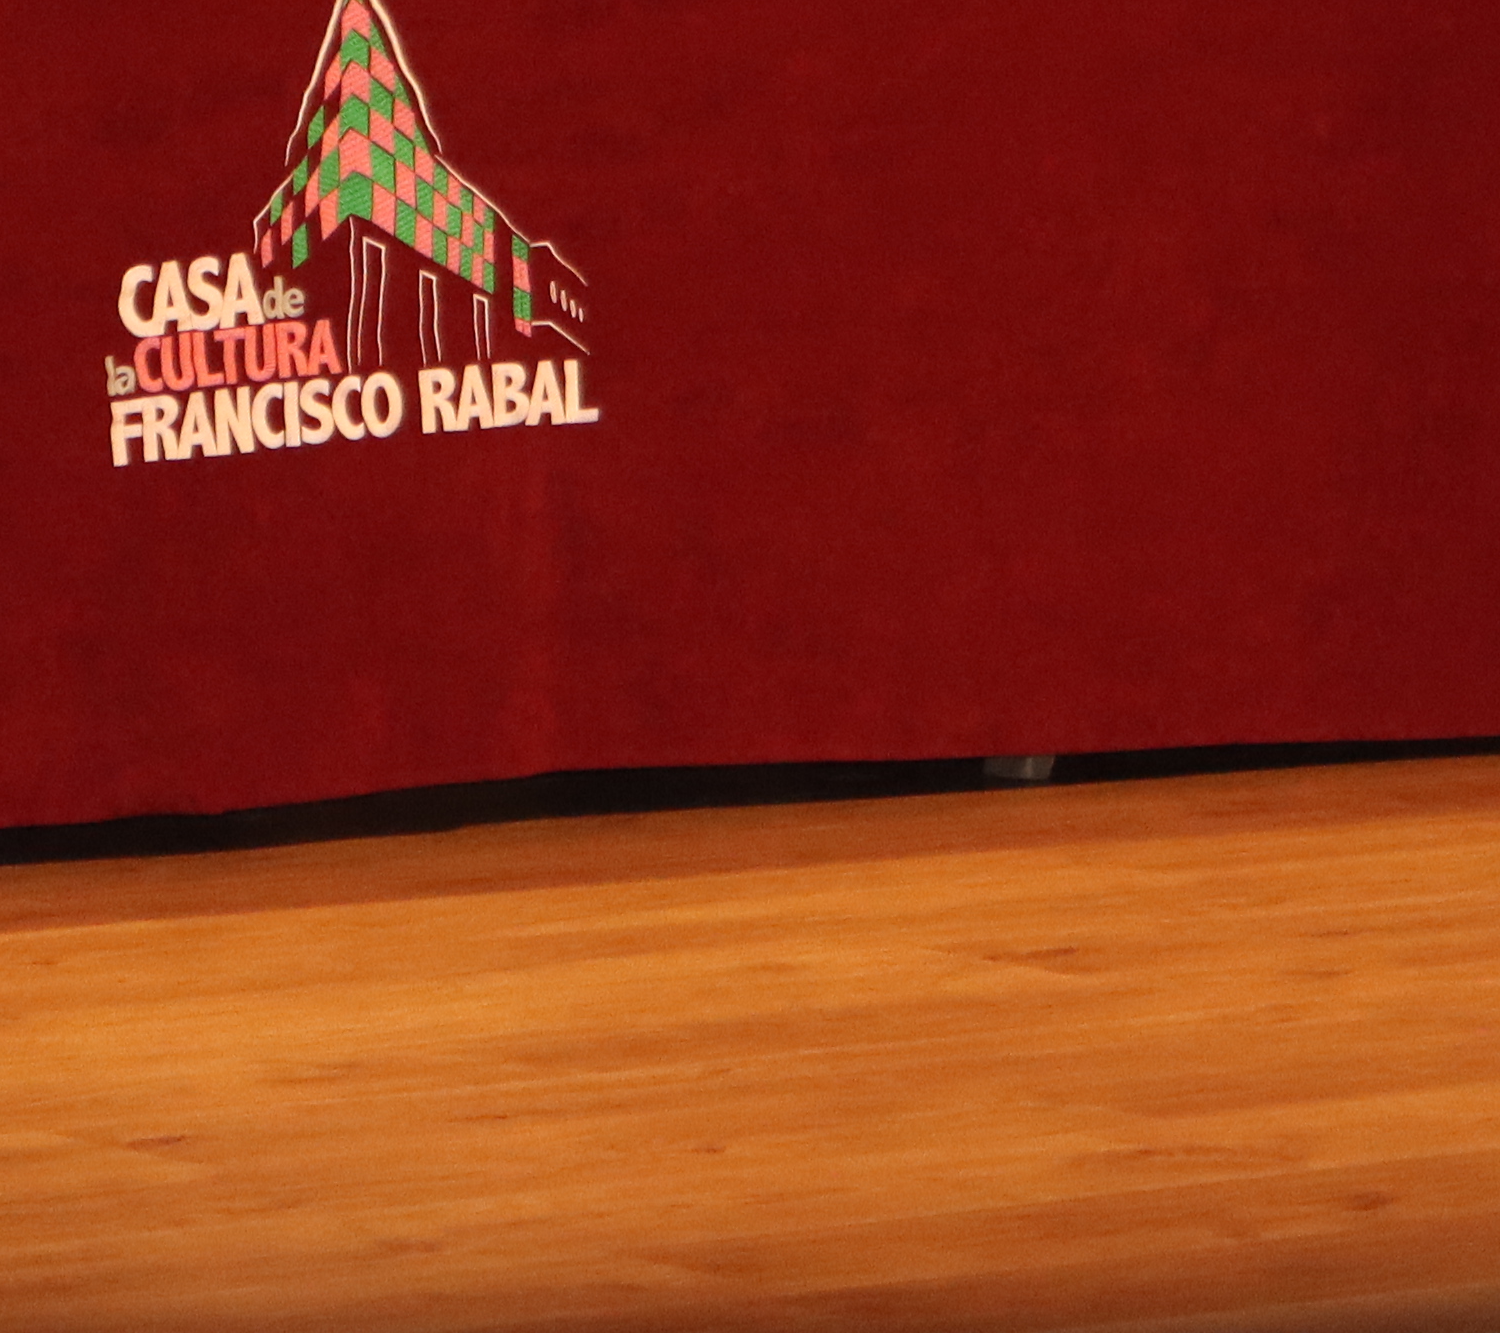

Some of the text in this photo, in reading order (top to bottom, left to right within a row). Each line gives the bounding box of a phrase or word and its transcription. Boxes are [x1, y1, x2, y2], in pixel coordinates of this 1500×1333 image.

[117, 251, 306, 338] CASA de
[104, 318, 343, 397] la CULTURA
[109, 358, 600, 468] FRANCISCO RABAL
